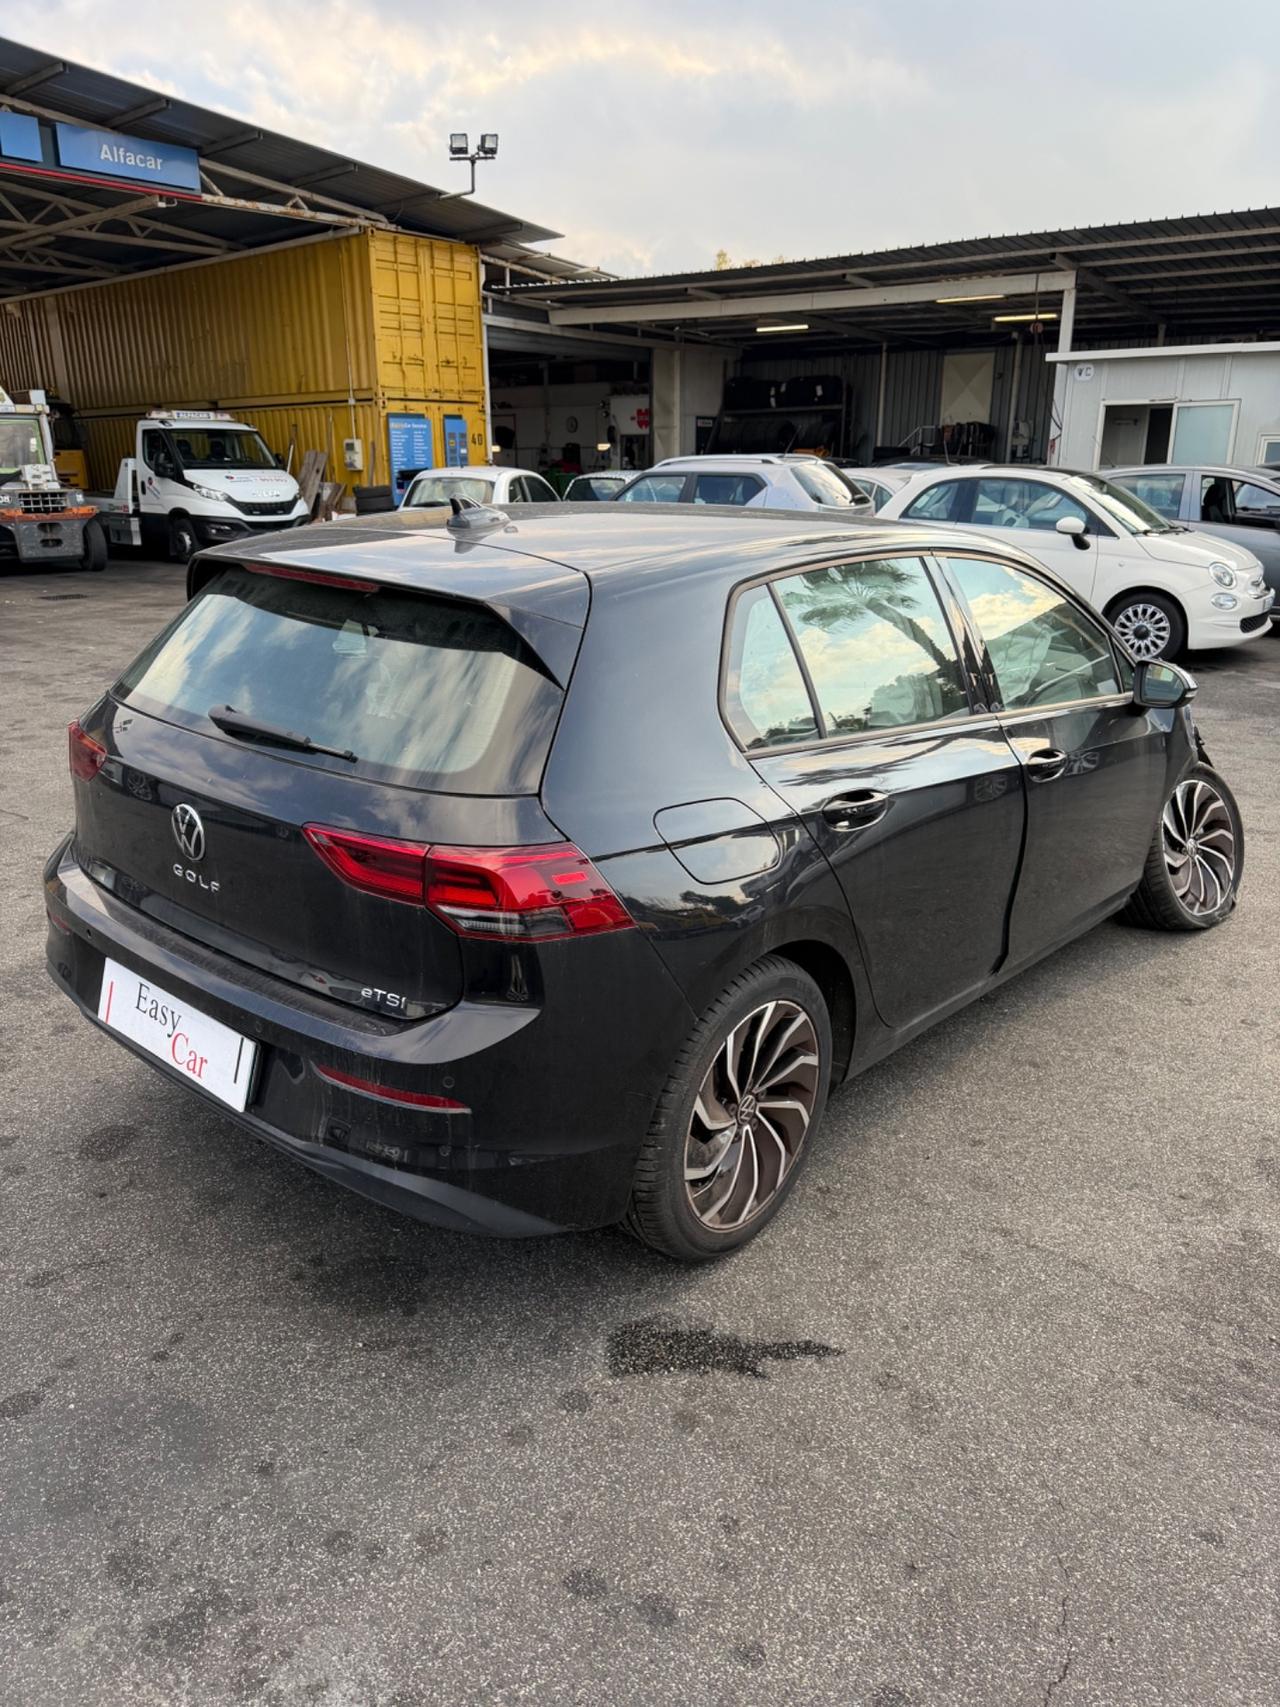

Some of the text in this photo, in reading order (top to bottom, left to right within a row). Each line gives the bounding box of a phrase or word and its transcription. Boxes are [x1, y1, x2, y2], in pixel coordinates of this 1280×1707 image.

[101, 144, 162, 170] Alfacar
[172, 863, 221, 893] GOLF
[134, 982, 182, 1038] Easy
[361, 987, 406, 1009] eTSI
[171, 1032, 208, 1079] Car
